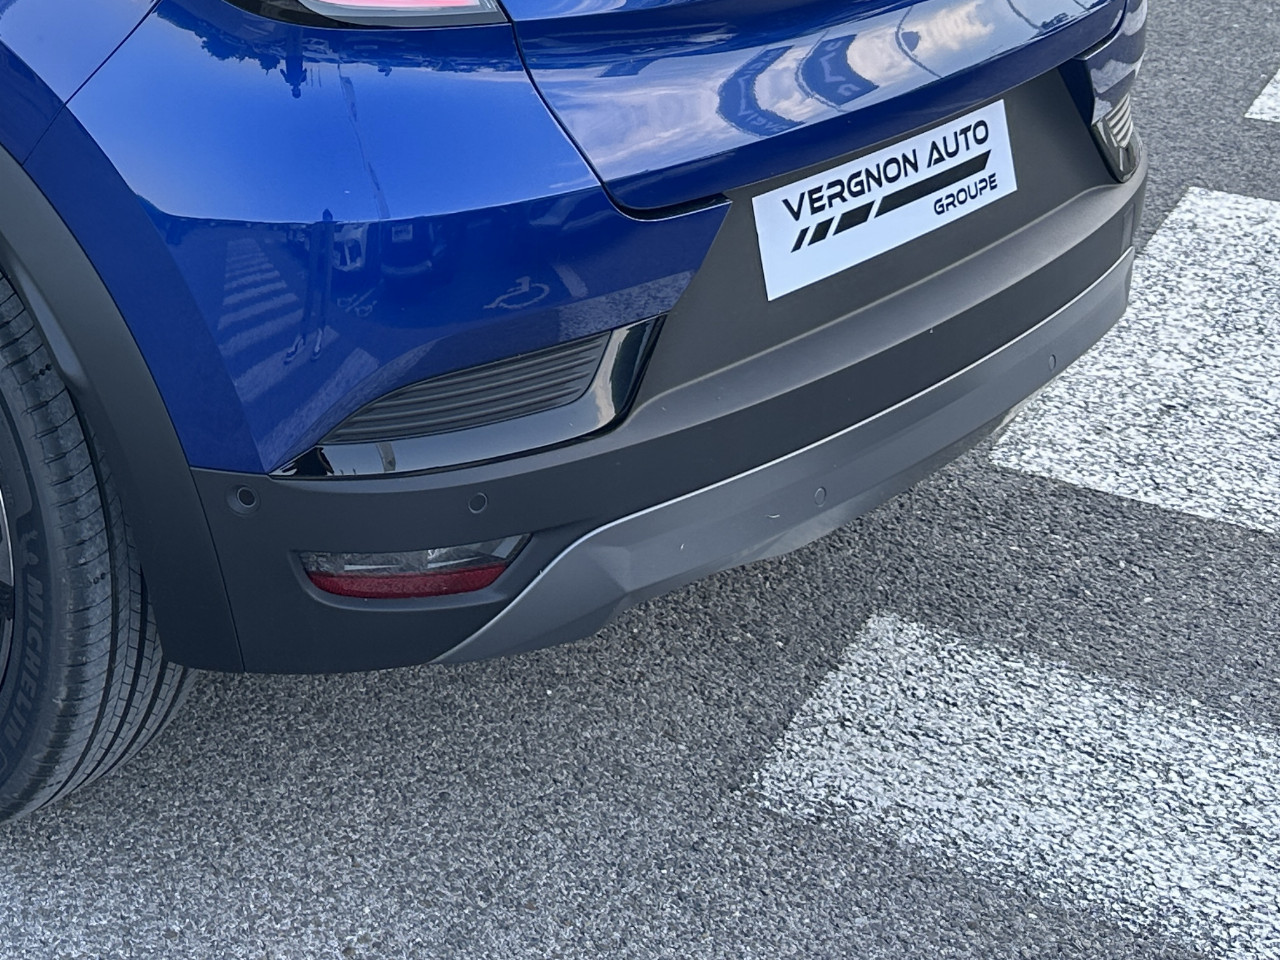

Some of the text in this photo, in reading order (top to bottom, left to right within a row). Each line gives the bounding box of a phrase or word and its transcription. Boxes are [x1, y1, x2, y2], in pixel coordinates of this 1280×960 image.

[781, 119, 990, 222] VERGNON AUTO
[933, 172, 998, 216] GROUPE
[4, 574, 44, 748] MICHELIN
